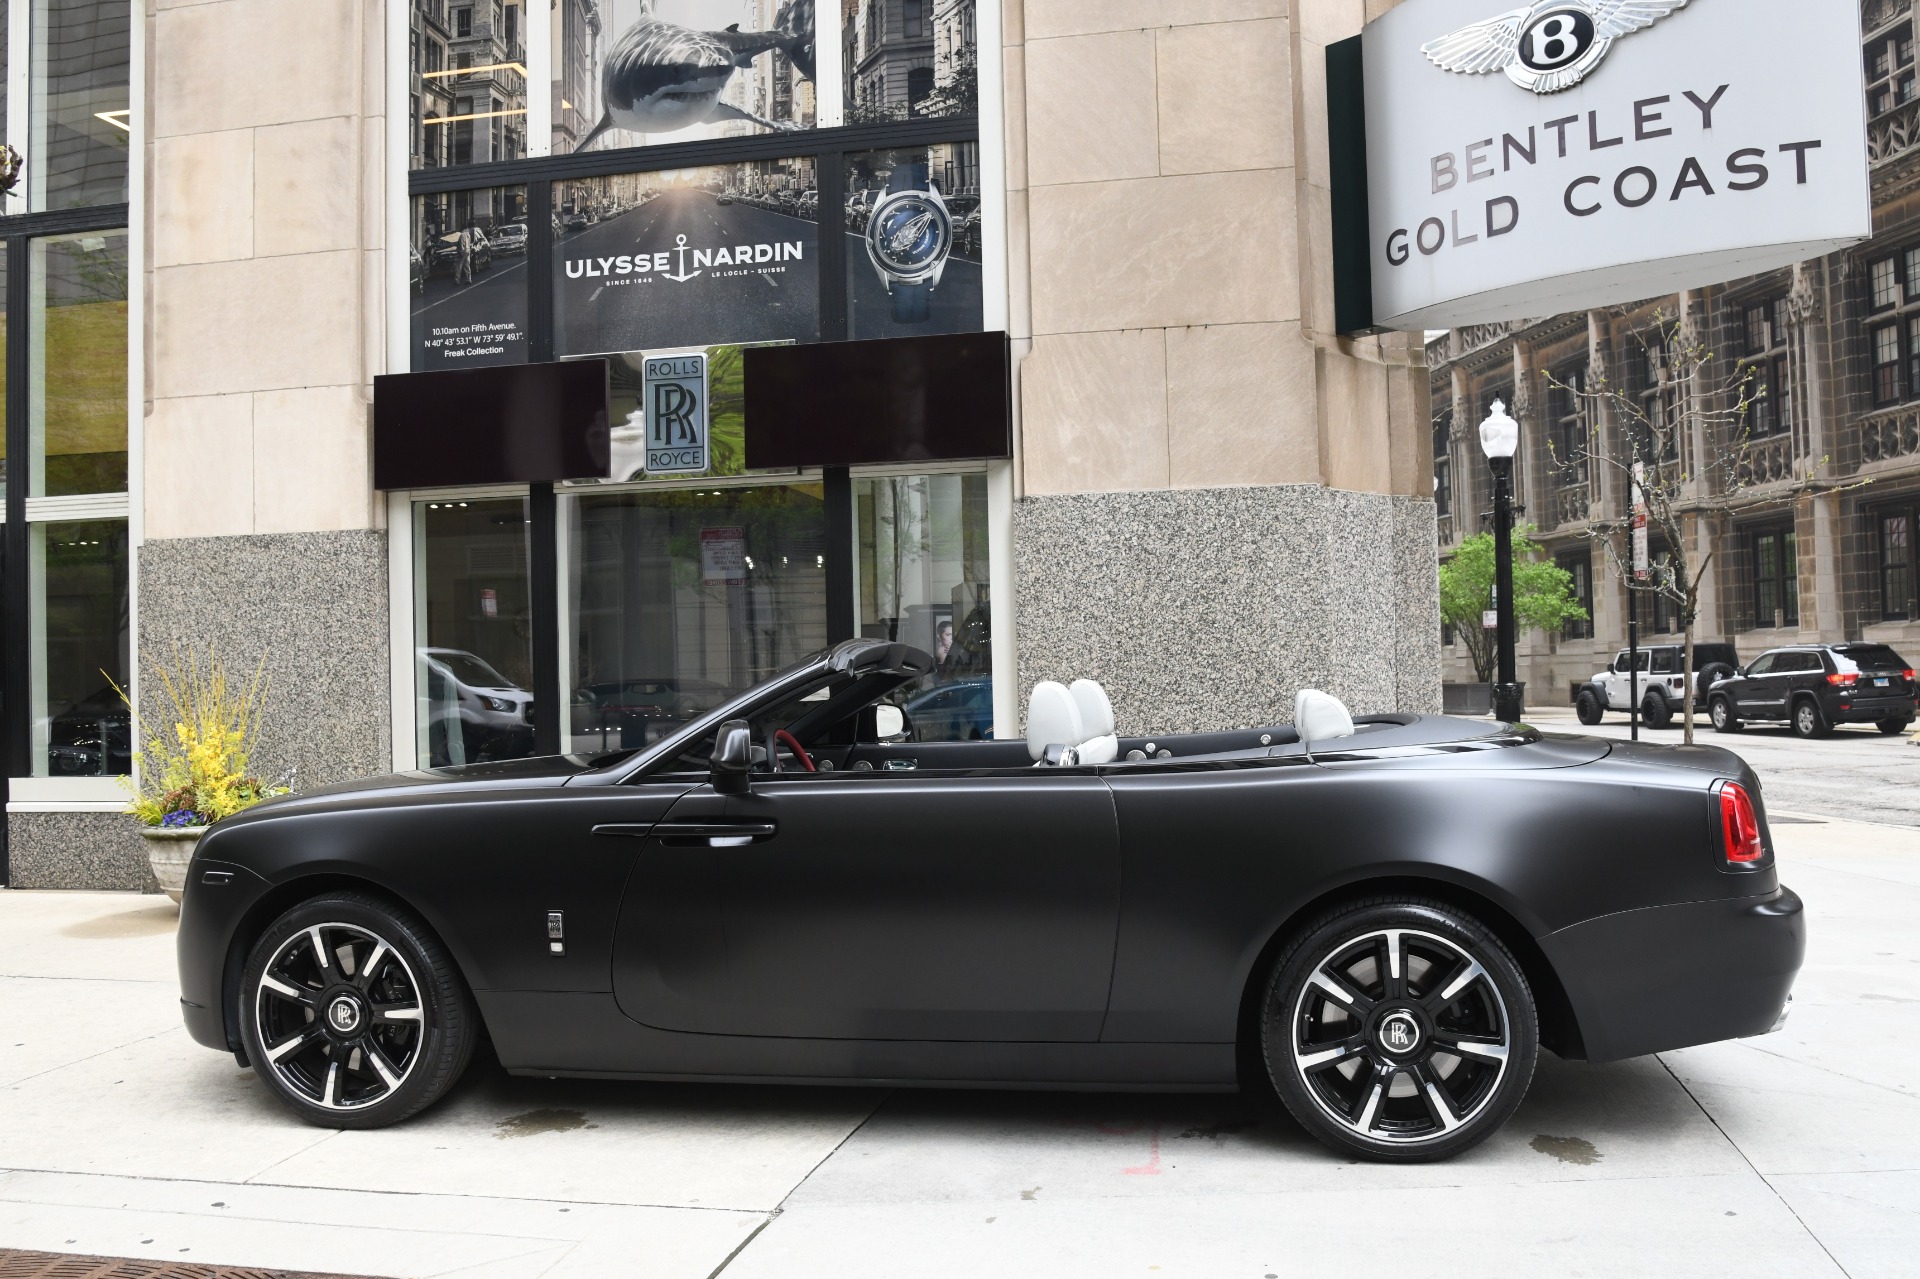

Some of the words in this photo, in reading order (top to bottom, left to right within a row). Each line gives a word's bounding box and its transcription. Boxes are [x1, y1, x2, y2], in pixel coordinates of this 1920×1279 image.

[1530, 14, 1578, 65] B
[1431, 84, 1729, 194] BENTLEY
[1386, 195, 1519, 266] GOLD
[1564, 139, 1821, 217] COAST
[566, 251, 670, 279] ULYSSE
[693, 241, 803, 268] NARDIN
[723, 269, 748, 277] LOCLE
[757, 266, 786, 274] SUISSE
[606, 278, 630, 287] SINCE
[432, 327, 459, 336] 10.10am
[471, 323, 487, 333] Fifth
[473, 335, 482, 343] W
[444, 349, 465, 358] Freak
[466, 346, 503, 356] Collection
[649, 360, 699, 377] ROLLS
[650, 450, 700, 466] ROYCE
